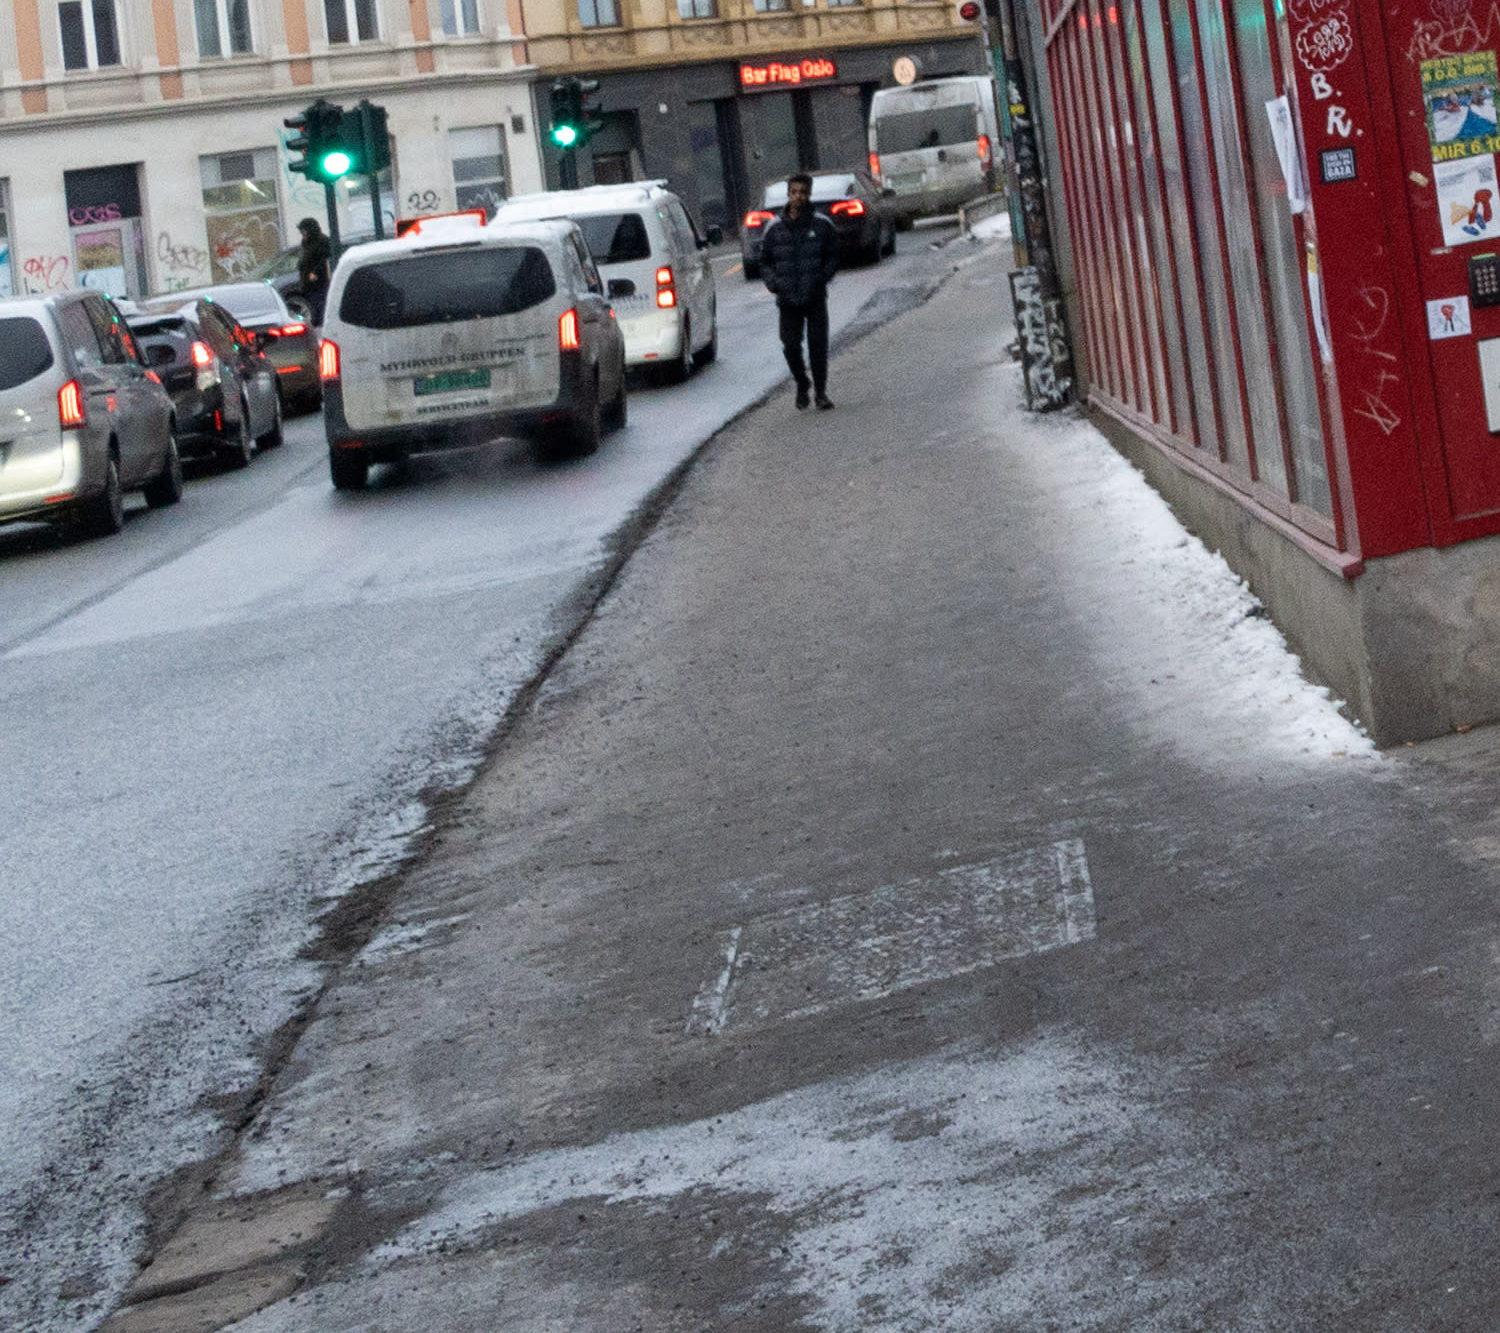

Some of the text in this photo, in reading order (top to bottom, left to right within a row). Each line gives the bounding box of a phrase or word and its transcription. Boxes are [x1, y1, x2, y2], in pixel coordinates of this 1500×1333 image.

[741, 66, 767, 85] Bar
[801, 59, 835, 79] Oslo
[1431, 141, 1467, 162] MIR
